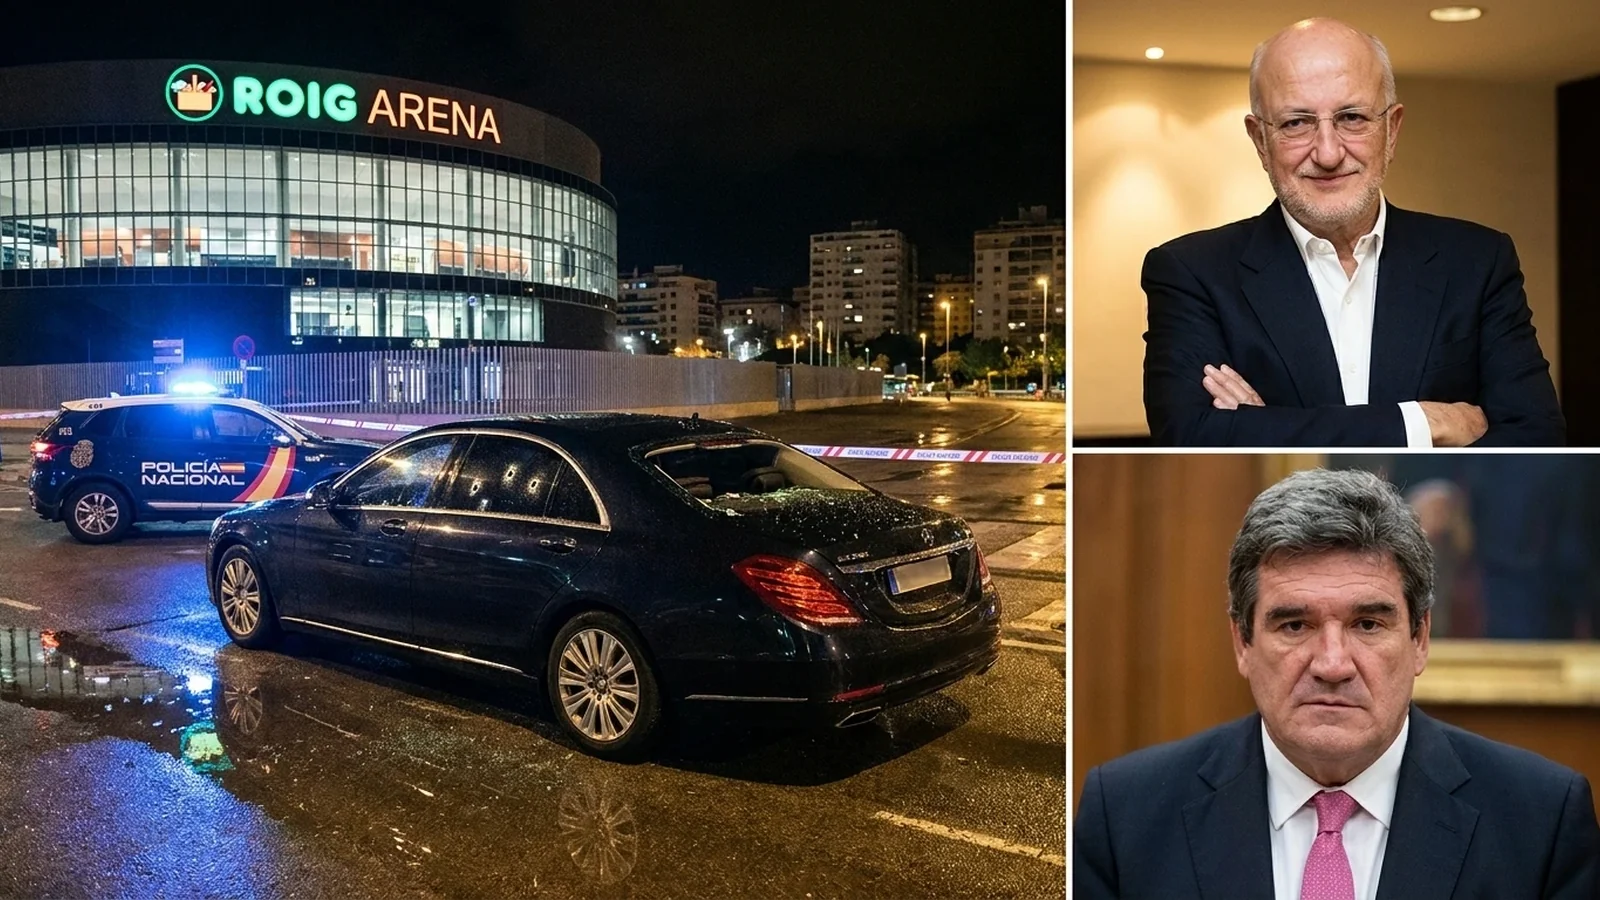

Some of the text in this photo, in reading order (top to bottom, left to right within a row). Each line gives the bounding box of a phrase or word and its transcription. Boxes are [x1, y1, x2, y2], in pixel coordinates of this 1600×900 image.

[233, 76, 501, 143] ROIG ARENA
[141, 459, 221, 473] POLICÍA
[141, 474, 245, 485] NACIONAL
